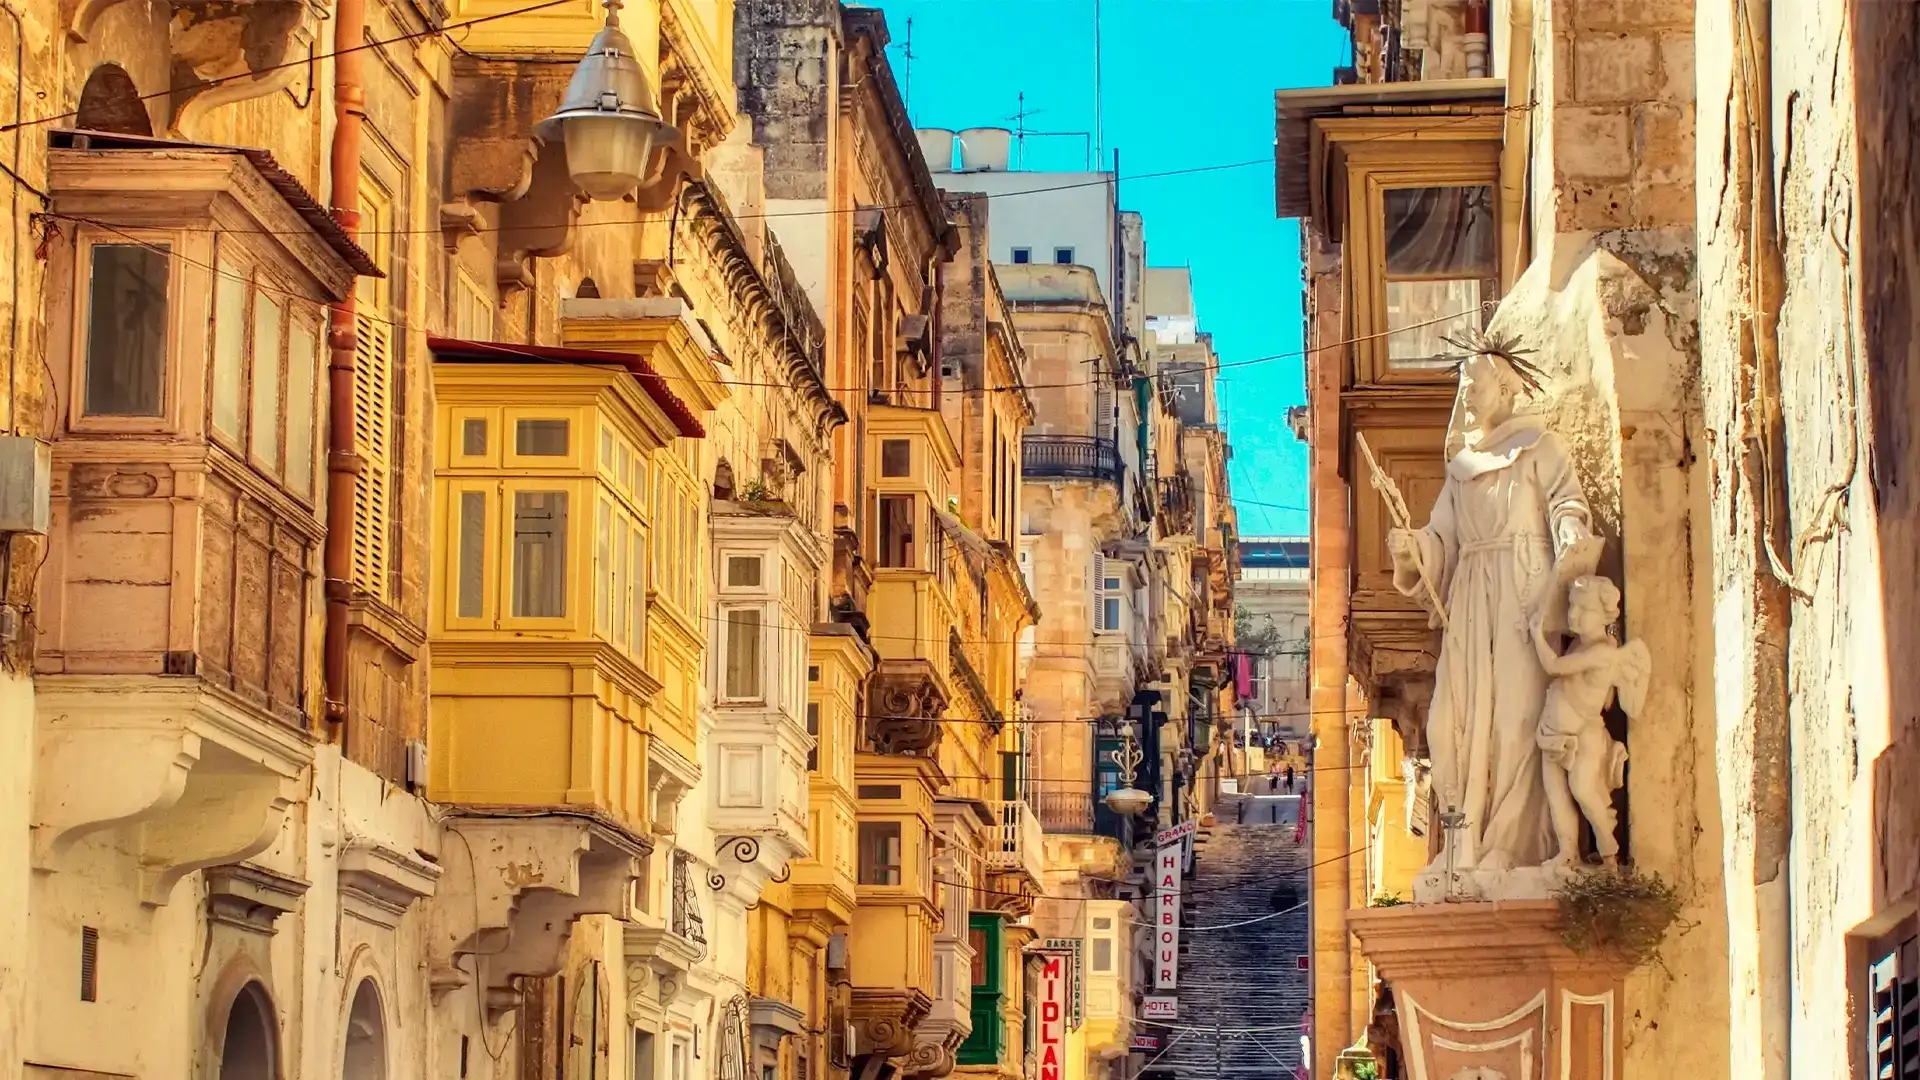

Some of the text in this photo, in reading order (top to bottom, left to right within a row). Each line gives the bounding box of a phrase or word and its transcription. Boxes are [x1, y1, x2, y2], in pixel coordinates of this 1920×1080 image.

[1158, 824, 1194, 843] GRAND
[1161, 856, 1175, 982] HARBOUR
[1047, 940, 1068, 948] BAR
[1144, 1002, 1176, 1011] HOTEL
